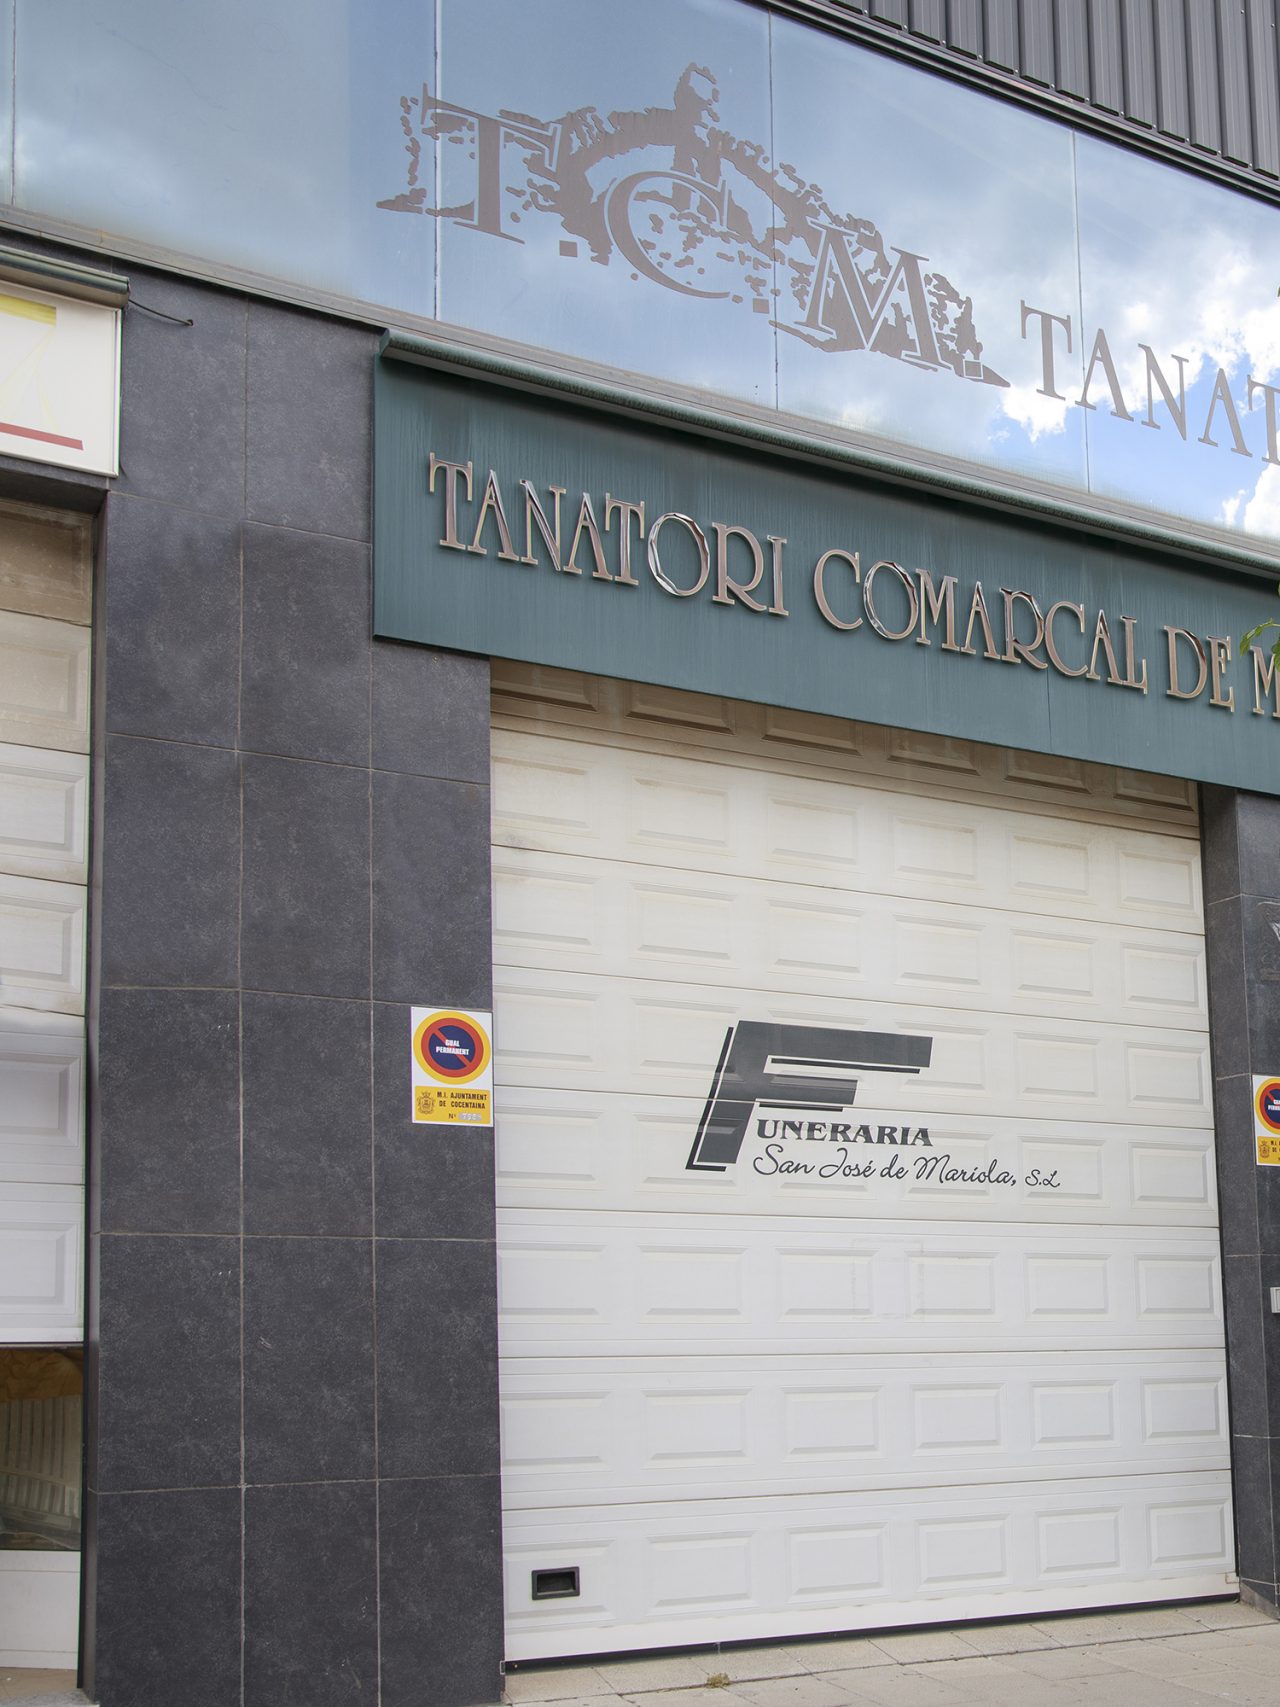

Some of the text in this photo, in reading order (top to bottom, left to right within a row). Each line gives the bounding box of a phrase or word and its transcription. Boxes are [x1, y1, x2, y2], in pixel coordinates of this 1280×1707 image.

[429, 452, 789, 616] TANATORI
[813, 548, 1147, 695] COMARCAL
[1164, 625, 1235, 713] DE
[450, 1092, 487, 1100] AJUNTAMENT
[451, 1101, 485, 1109] COCENTAINA
[753, 1143, 815, 1176] San
[818, 1147, 874, 1178] José
[880, 1154, 908, 1180] de
